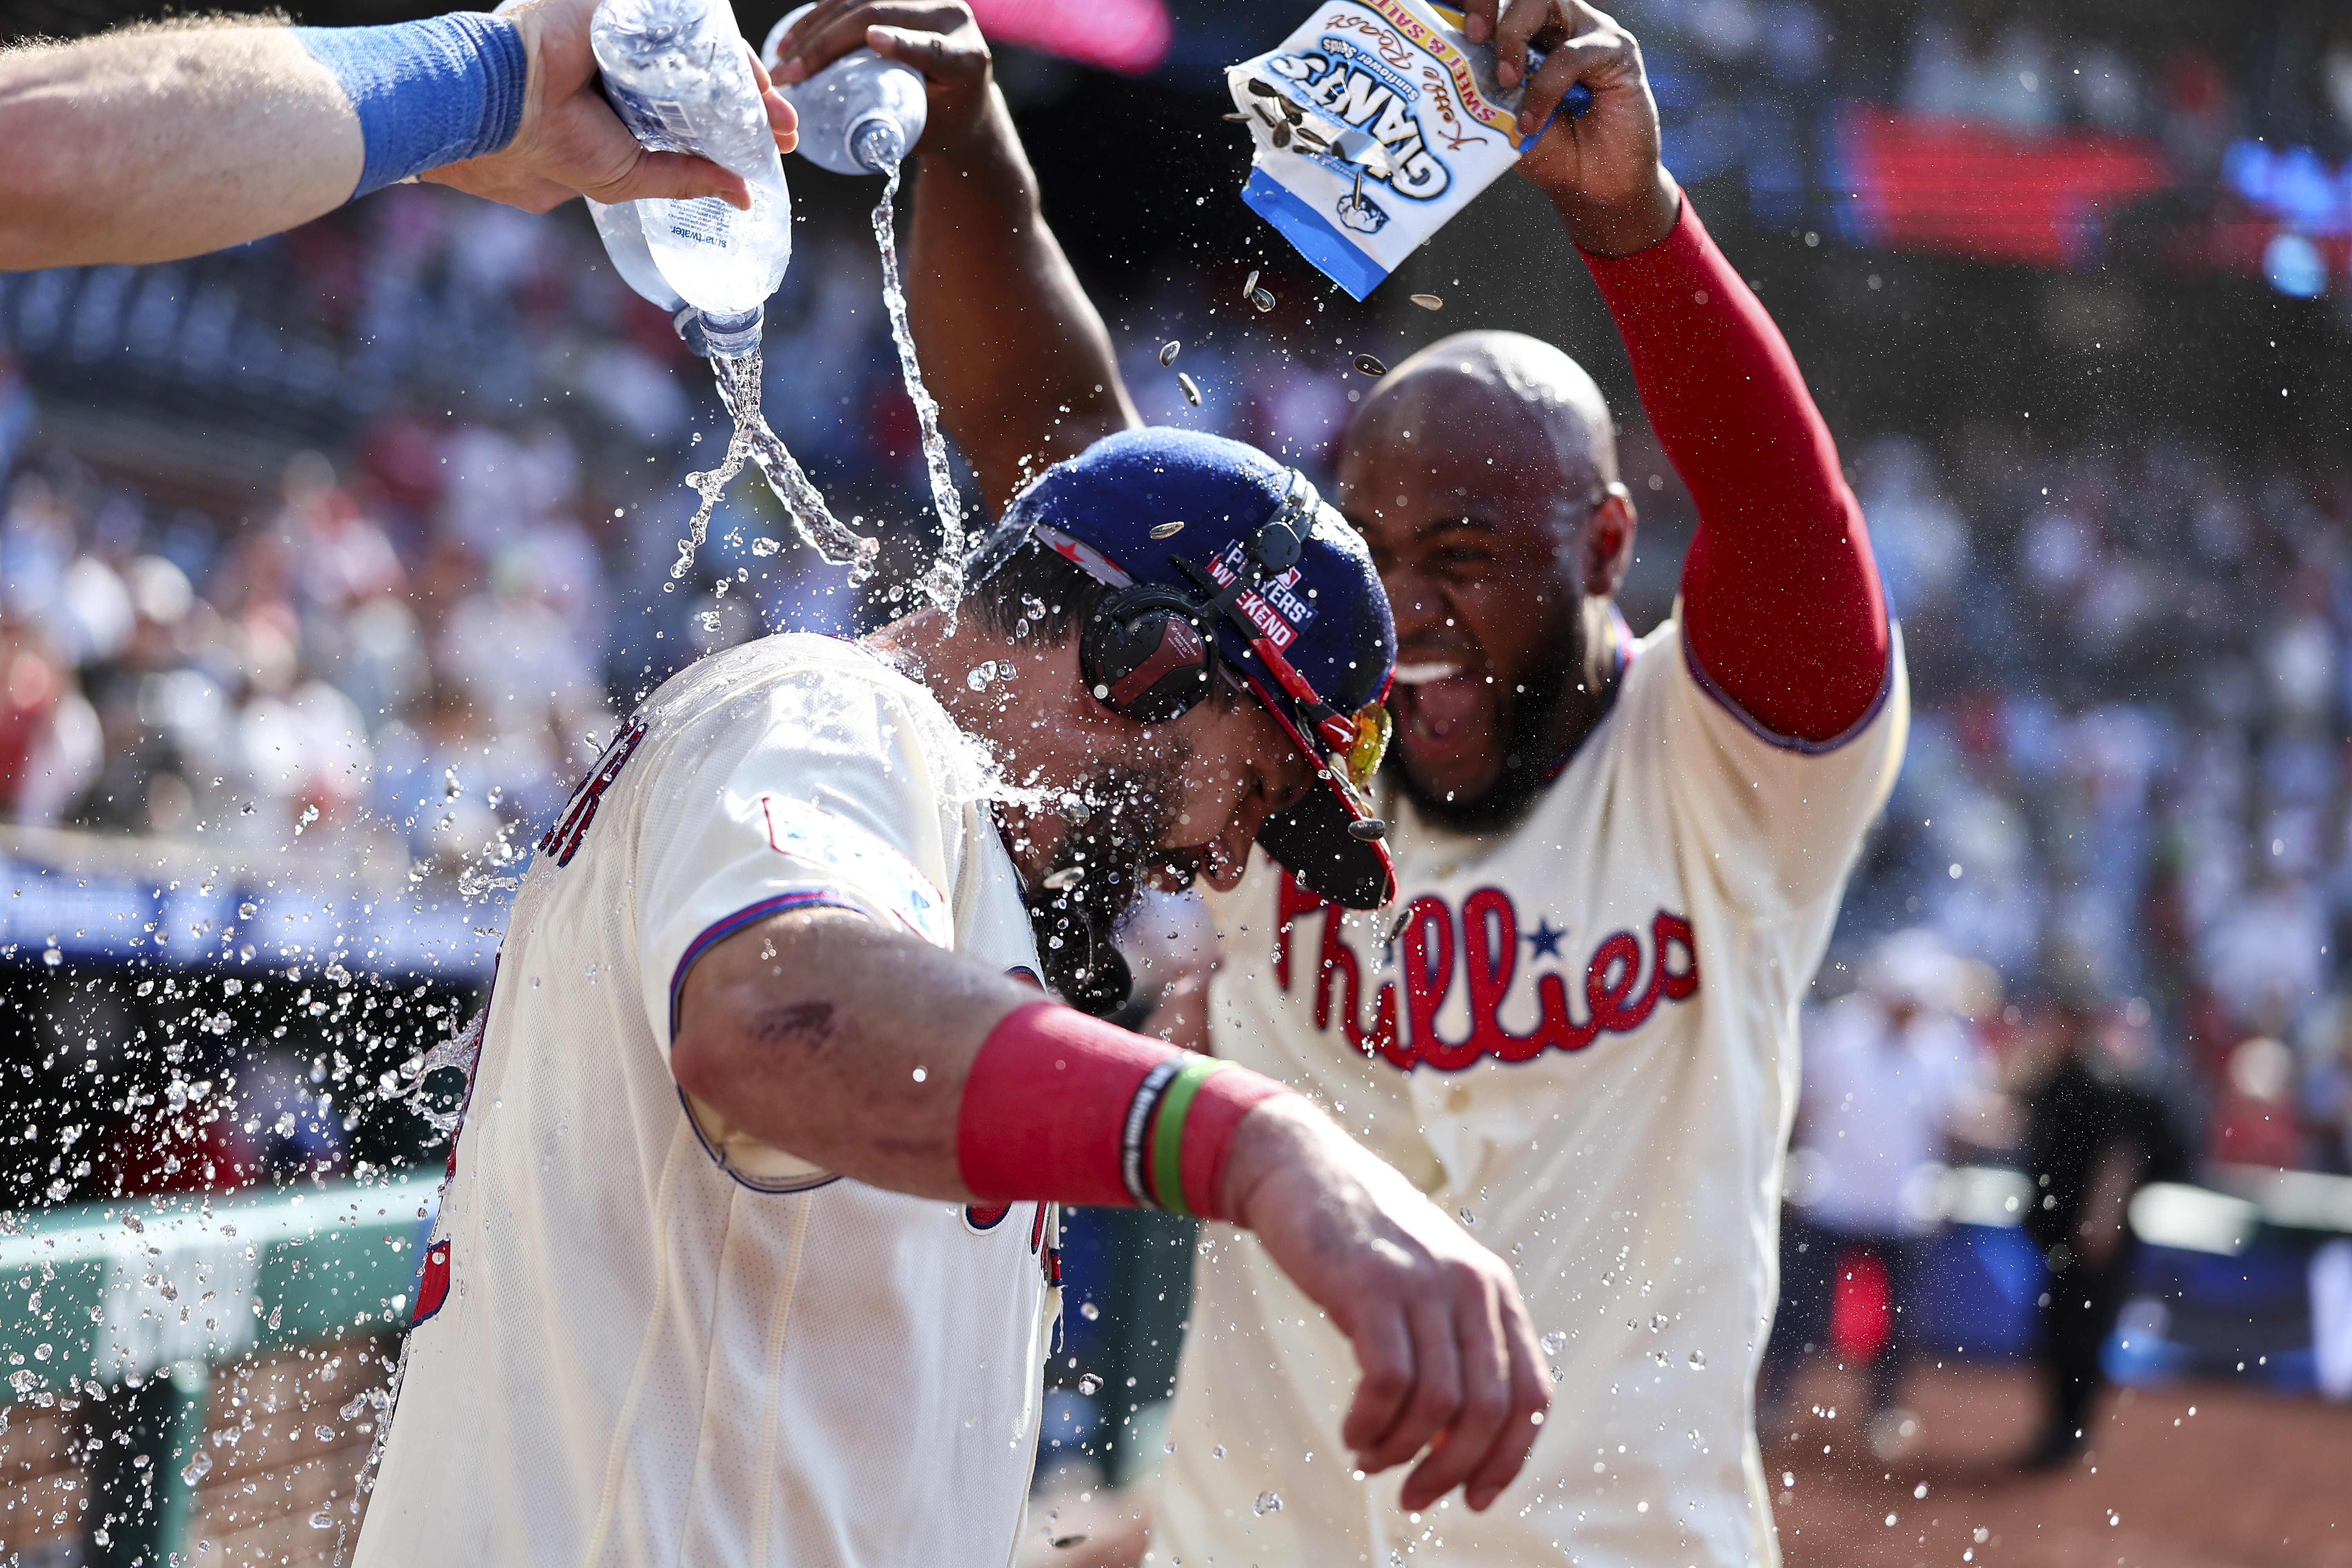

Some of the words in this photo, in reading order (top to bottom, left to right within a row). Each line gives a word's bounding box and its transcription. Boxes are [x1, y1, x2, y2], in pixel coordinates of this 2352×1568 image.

[1325, 15, 1414, 71] Roast
[1368, 0, 1425, 38] SALT
[1430, 38, 1446, 54] &
[1357, 54, 1418, 102] Sunflower
[1446, 57, 1497, 121] SWEET
[1269, 56, 1447, 198] GIANTS
[1423, 67, 1488, 151] Kettle
[1211, 562, 1292, 647] WEKEND
